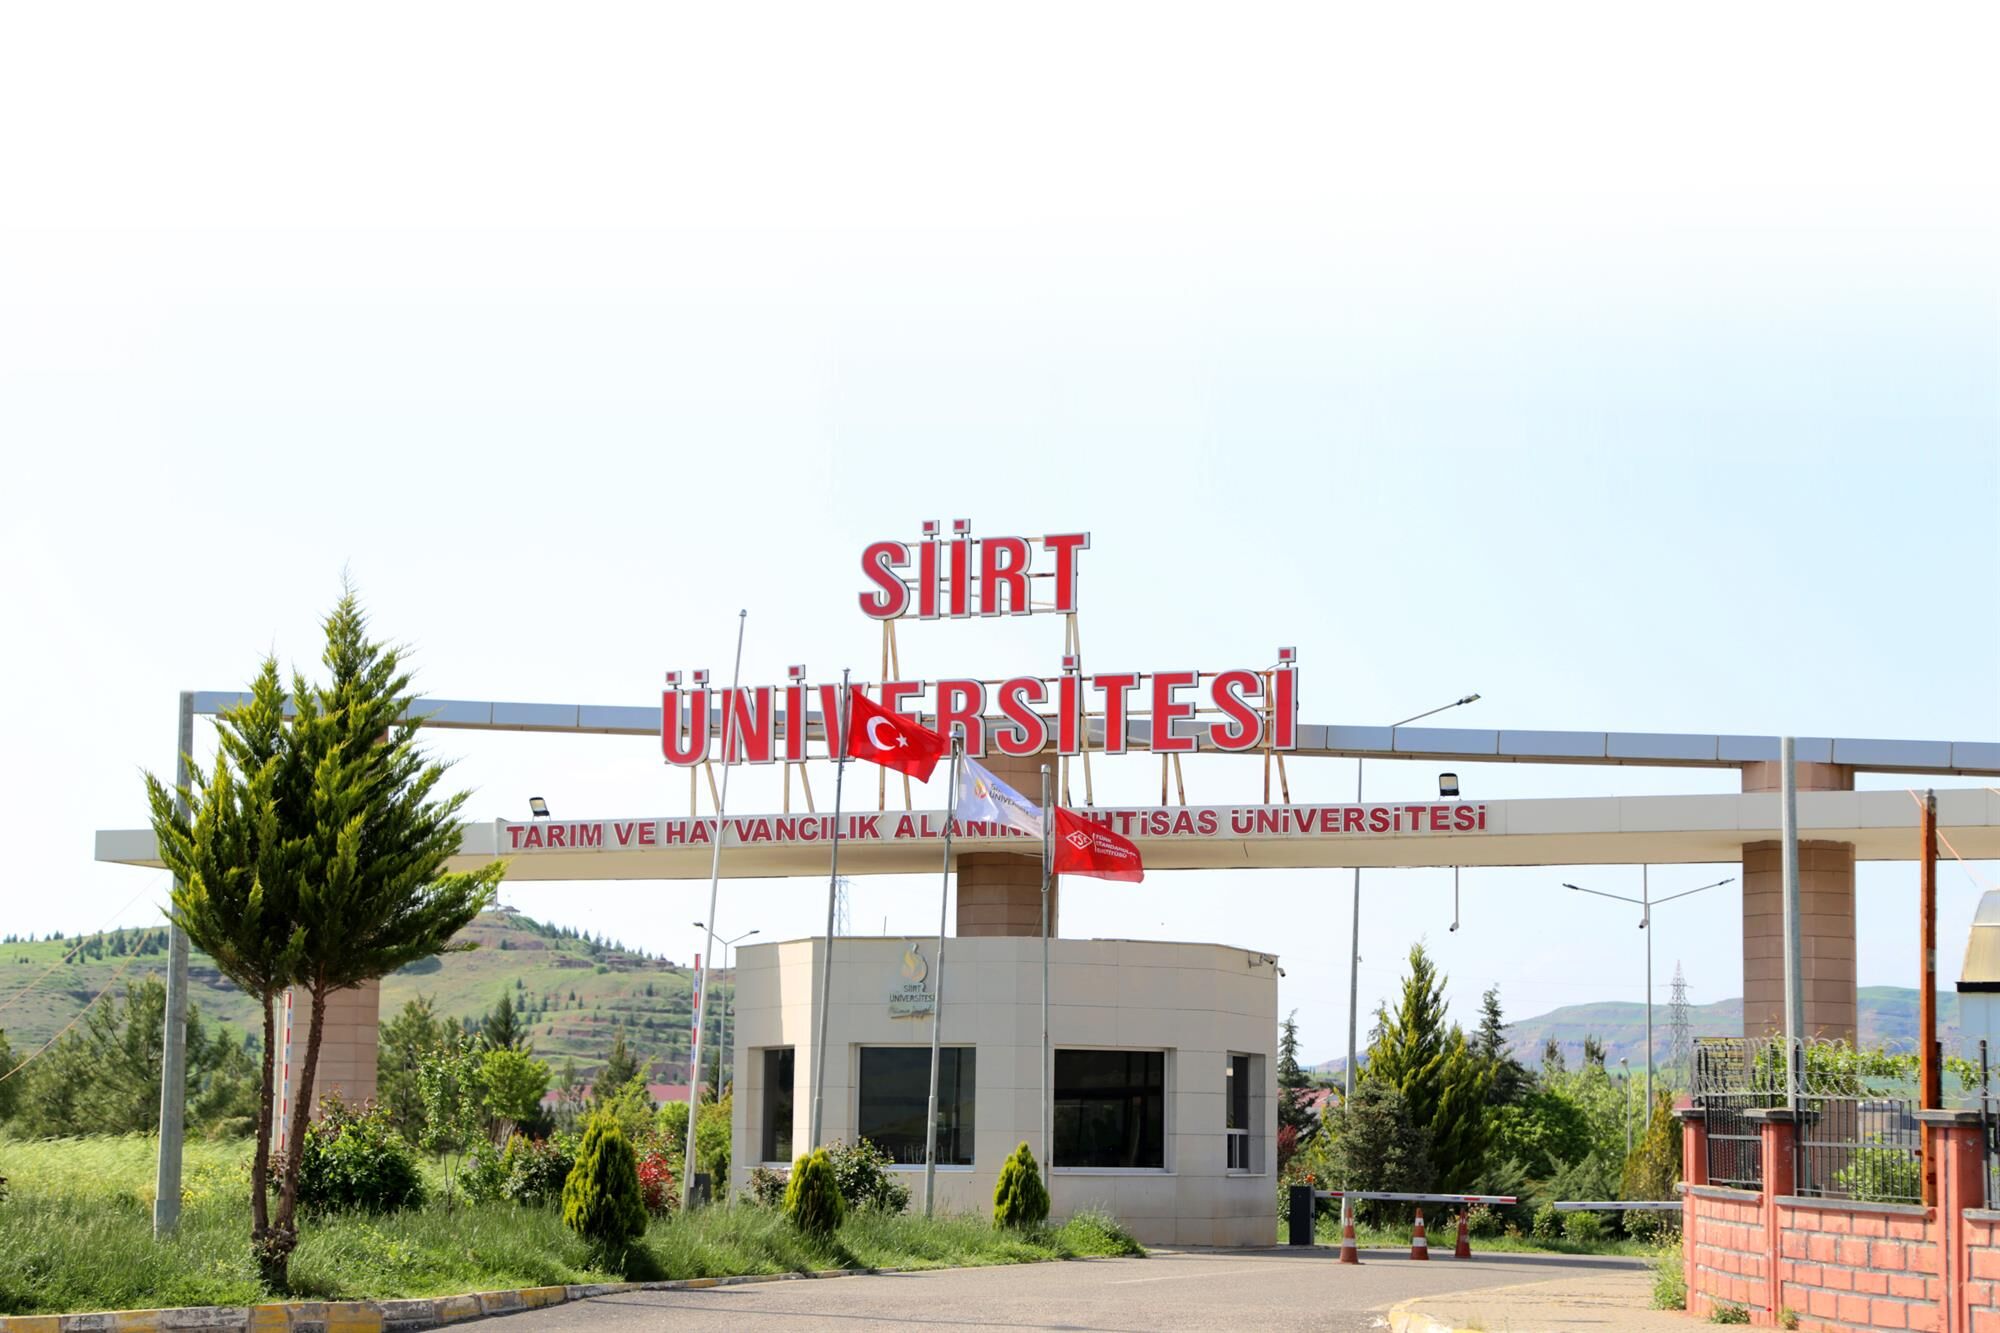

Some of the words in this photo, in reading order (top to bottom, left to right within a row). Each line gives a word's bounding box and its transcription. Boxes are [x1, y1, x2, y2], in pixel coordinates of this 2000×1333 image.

[858, 519, 1091, 620] SİİRT
[506, 824, 602, 849] TARIM
[613, 821, 656, 846] VE
[666, 815, 880, 844] HAYVANCILIK
